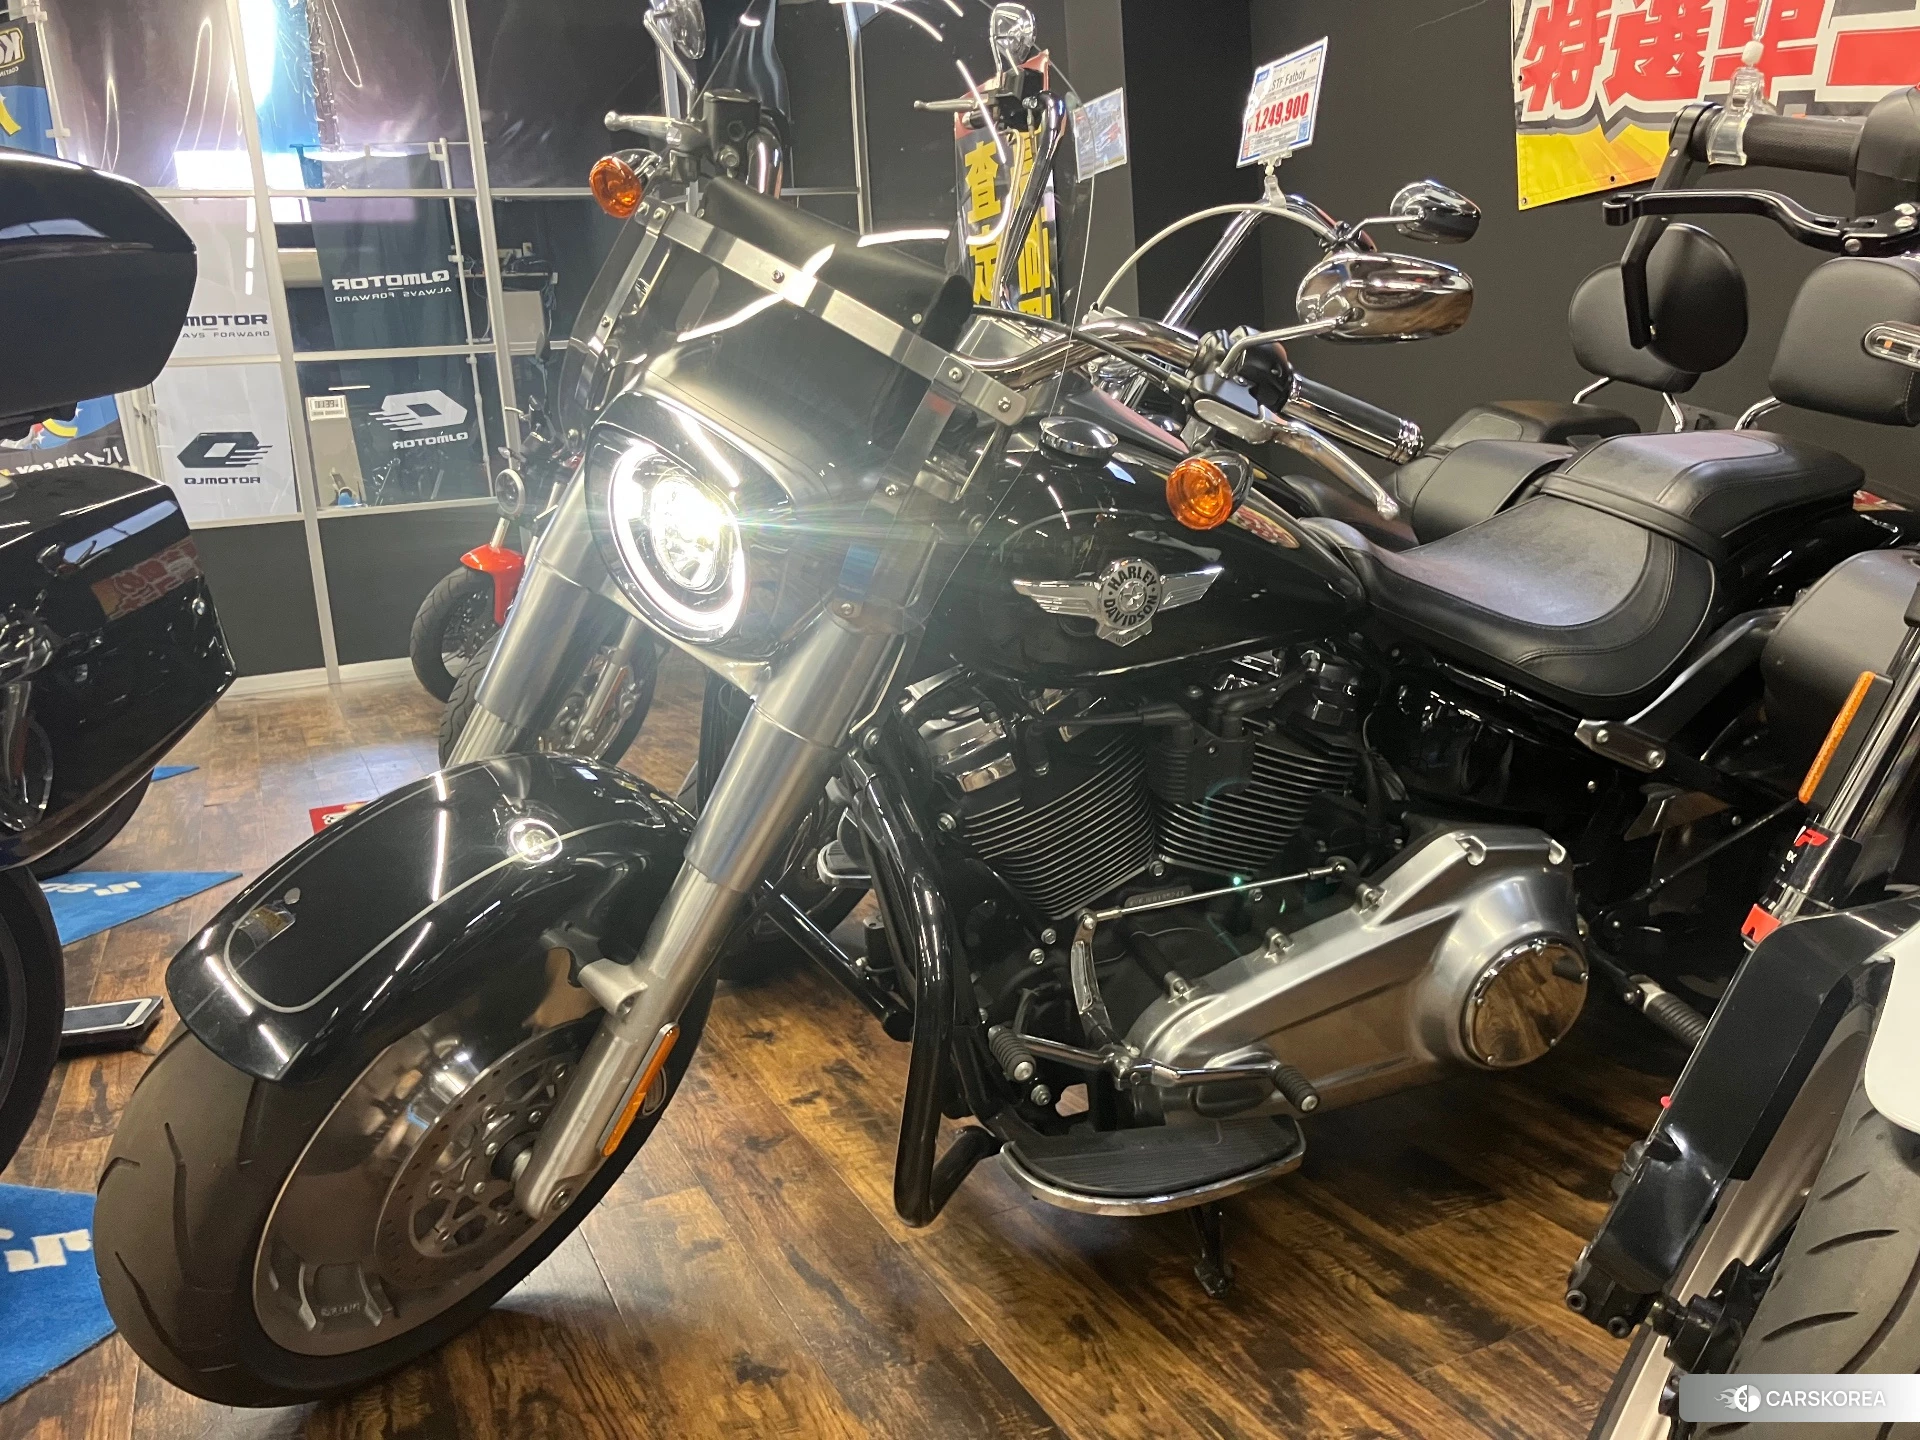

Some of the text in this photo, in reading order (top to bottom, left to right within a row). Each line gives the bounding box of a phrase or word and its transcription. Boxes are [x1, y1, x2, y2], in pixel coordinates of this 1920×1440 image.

[1284, 68, 1307, 86] Fatboy
[183, 314, 268, 326] MOTOR
[213, 330, 270, 338] FORWARD
[184, 476, 261, 485] QJMOTOR
[1108, 565, 1157, 592] HARLEY
[1103, 594, 1158, 627] DAVIDSON
